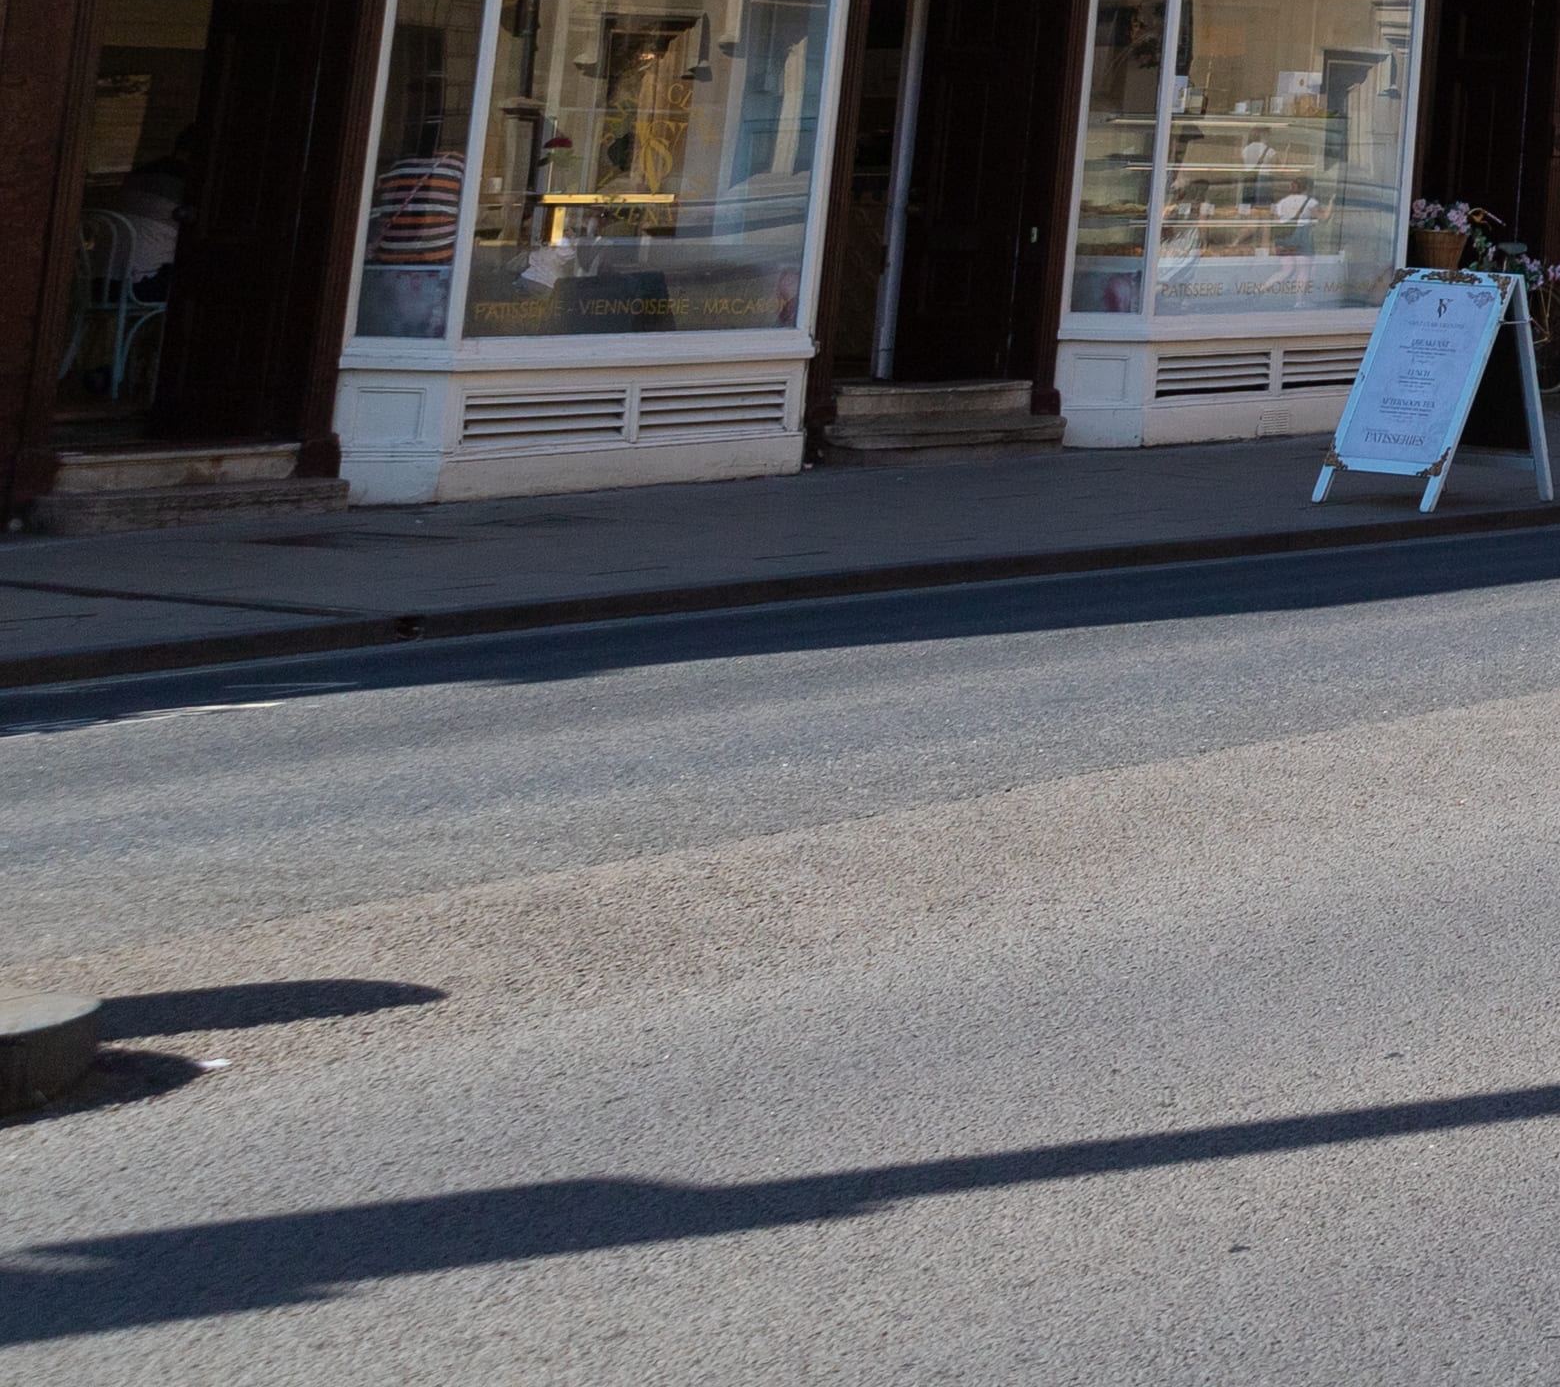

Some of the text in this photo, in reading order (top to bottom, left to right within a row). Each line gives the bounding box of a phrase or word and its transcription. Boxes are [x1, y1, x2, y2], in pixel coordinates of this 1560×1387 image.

[1161, 282, 1223, 298] PATISSERIE
[1235, 281, 1313, 296] VIENNOISERIE
[579, 298, 689, 317] VIENNOISERIE
[1364, 431, 1425, 447] PATISSERIES
